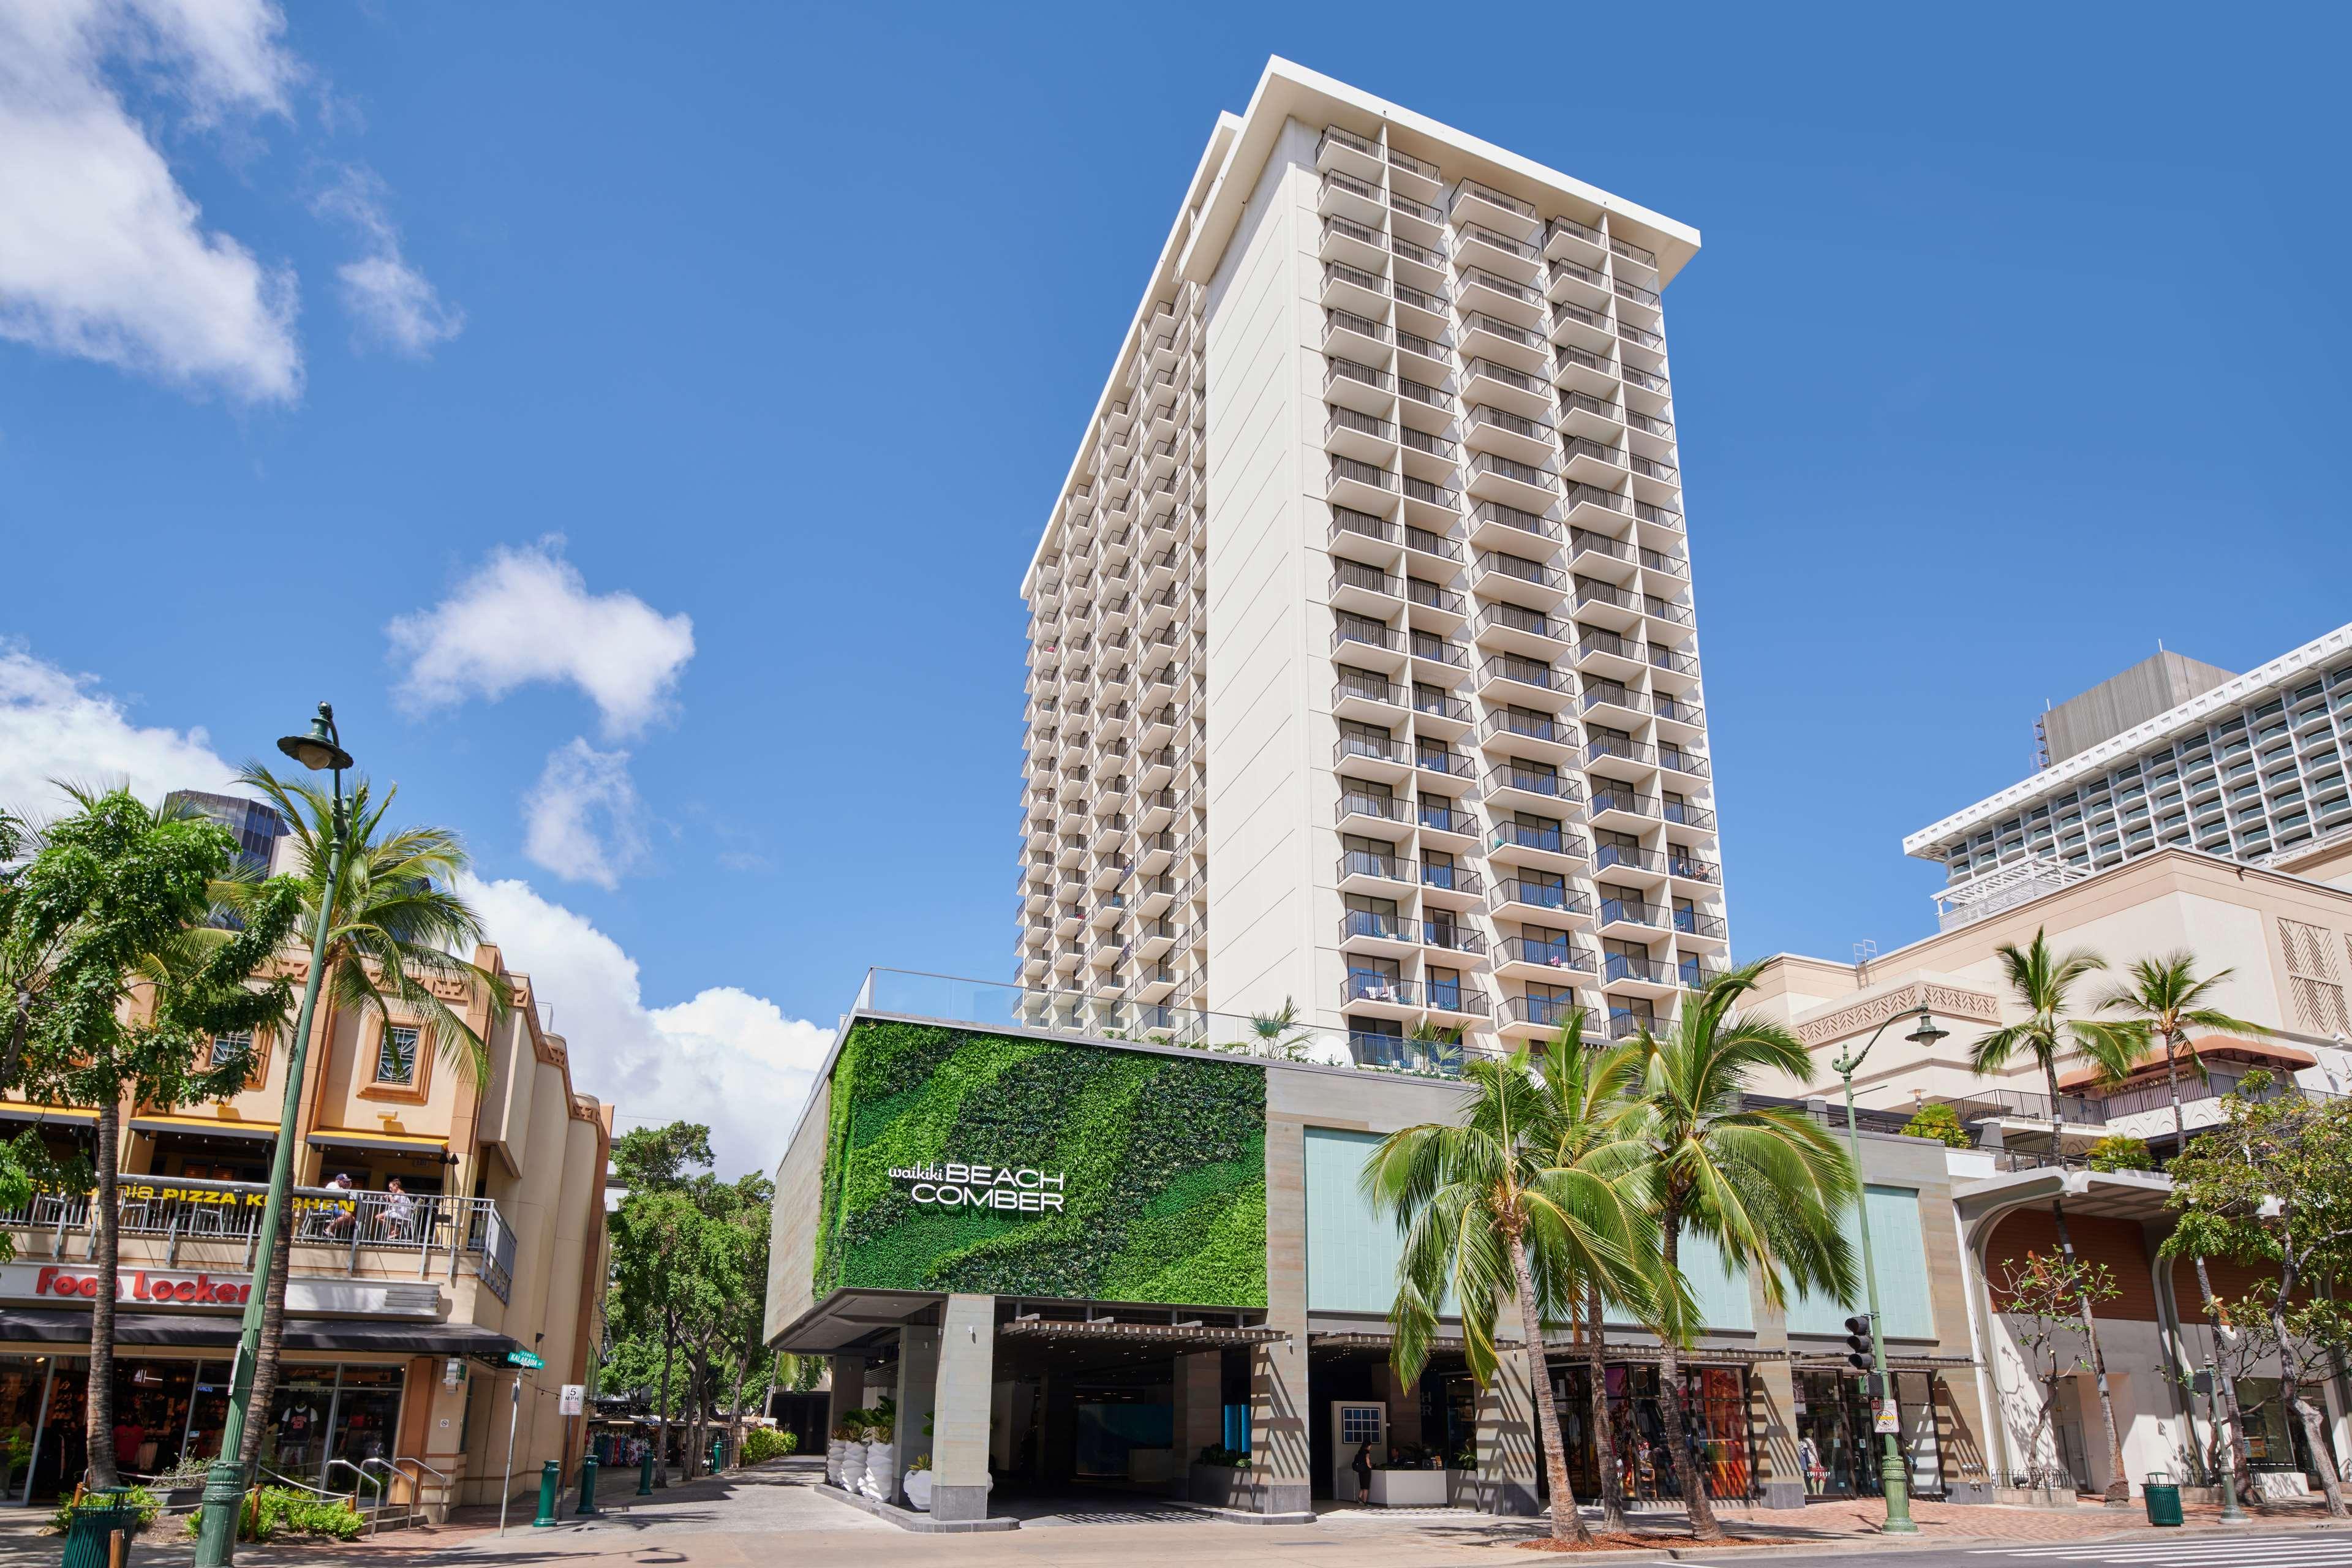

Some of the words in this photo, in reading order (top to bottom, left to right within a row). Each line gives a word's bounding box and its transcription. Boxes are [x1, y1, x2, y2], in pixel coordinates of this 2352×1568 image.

[888, 1161, 943, 1182] waikiki
[945, 1163, 1064, 1191] BEACH
[162, 1188, 236, 1205] PIZZA
[246, 1194, 355, 1212] KICHEN
[911, 1183, 1064, 1212] COMBER
[35, 1267, 118, 1297] Foo
[132, 1271, 252, 1303] Locker
[510, 1354, 537, 1366] KALAKAUA
